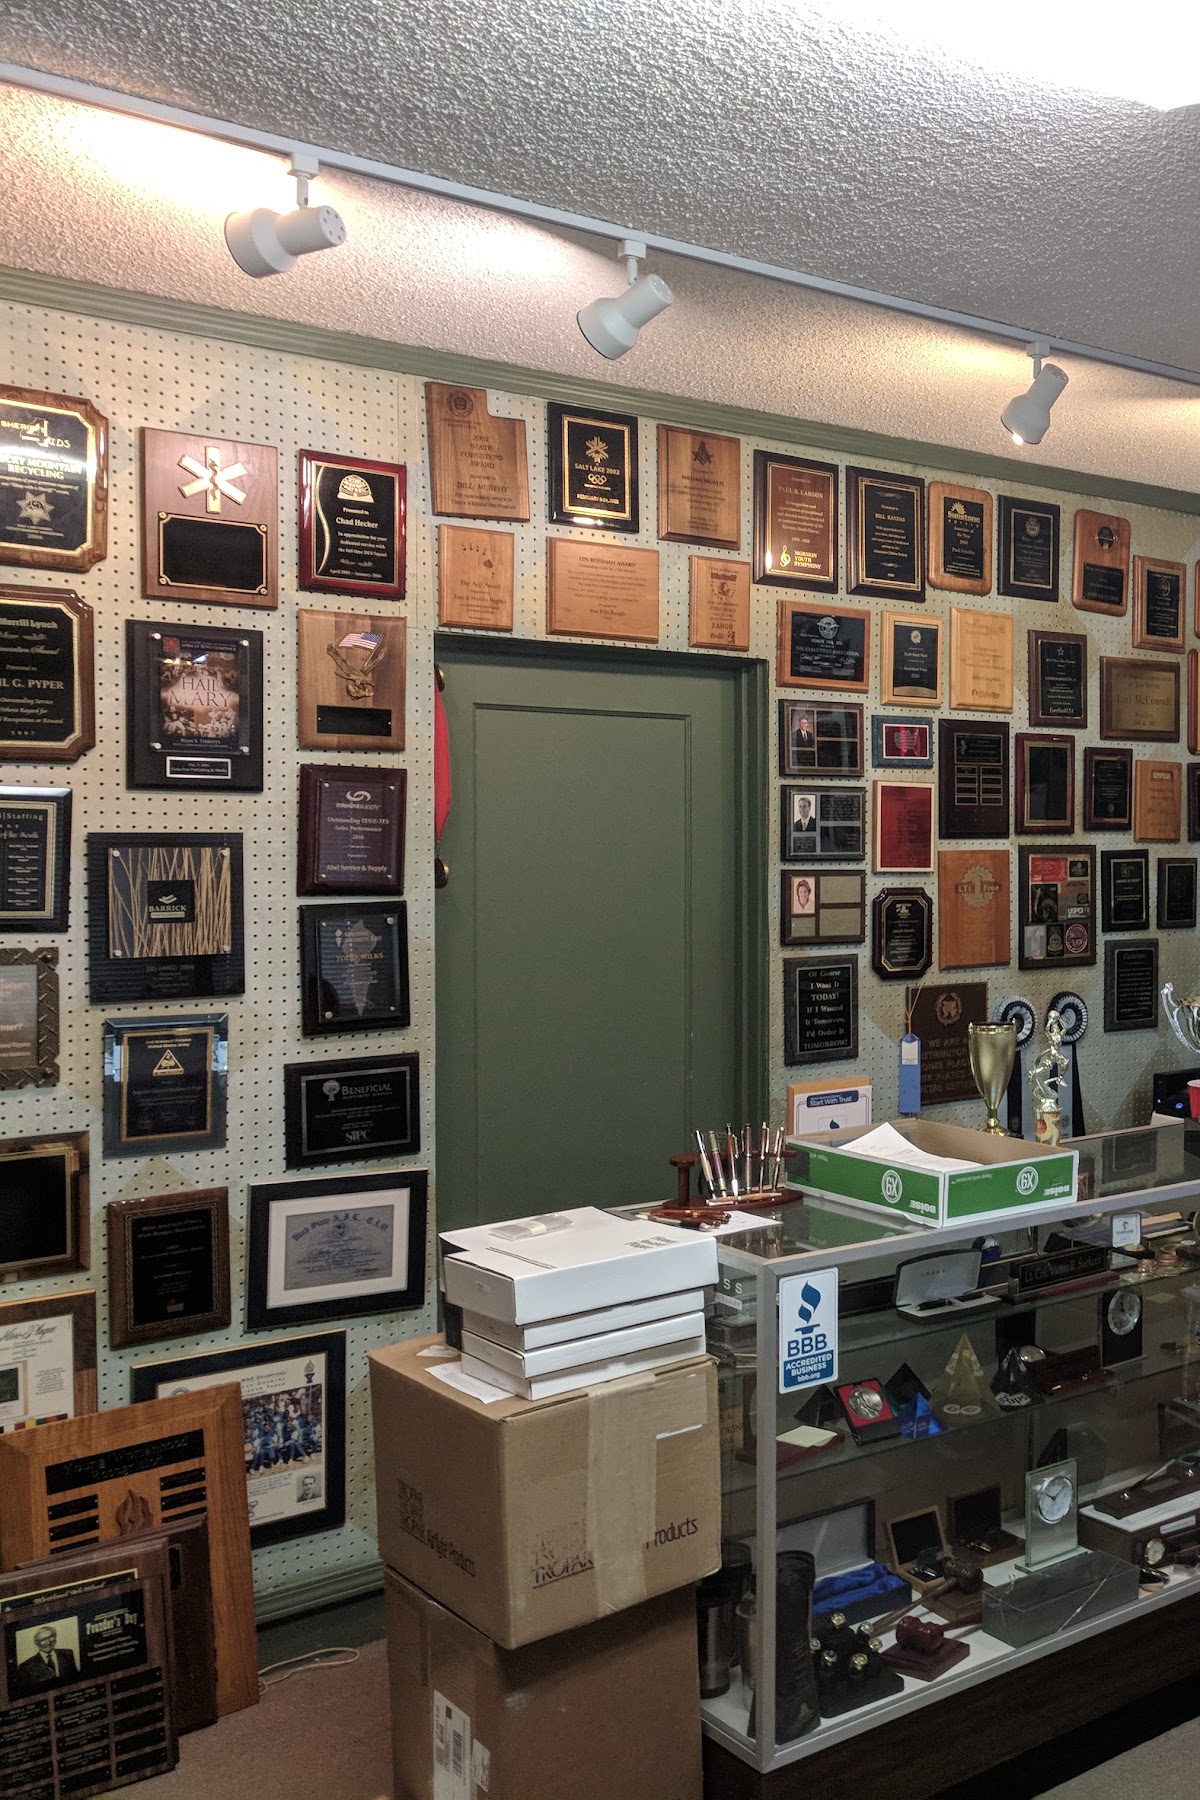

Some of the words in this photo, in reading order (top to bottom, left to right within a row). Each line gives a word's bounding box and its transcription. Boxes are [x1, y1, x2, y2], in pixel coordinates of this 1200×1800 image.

[460, 452, 503, 460] FORESTERS
[7, 465, 64, 479] RECYCLING
[605, 467, 619, 475] 2002
[456, 481, 473, 489] BILL
[477, 484, 509, 492] MURPHY
[800, 490, 823, 498] LARSON
[947, 510, 980, 522] Sunstone
[335, 516, 353, 526] Chad
[354, 518, 378, 528] Hecker
[794, 550, 817, 558] MORMON
[794, 561, 821, 569] SYMPHONY
[30, 620, 57, 629] Lynch
[27, 679, 64, 689] PYPER
[181, 677, 218, 691] HAIL
[168, 690, 231, 707] MARY
[367, 865, 387, 873] Supply
[148, 904, 187, 912] BARRICK
[820, 969, 840, 977] Course
[810, 992, 839, 1001] TODAY!
[820, 1004, 843, 1012] Wanted
[817, 1028, 836, 1036] Order
[803, 1038, 847, 1049] TOMORROW!
[341, 1083, 392, 1095] BENEFICIAL
[809, 1098, 823, 1106] Start
[787, 1333, 827, 1357] BBB
[785, 1352, 832, 1370] ACCREDITED
[790, 1361, 826, 1376] BUSINESS
[797, 1371, 820, 1381] bbb.org
